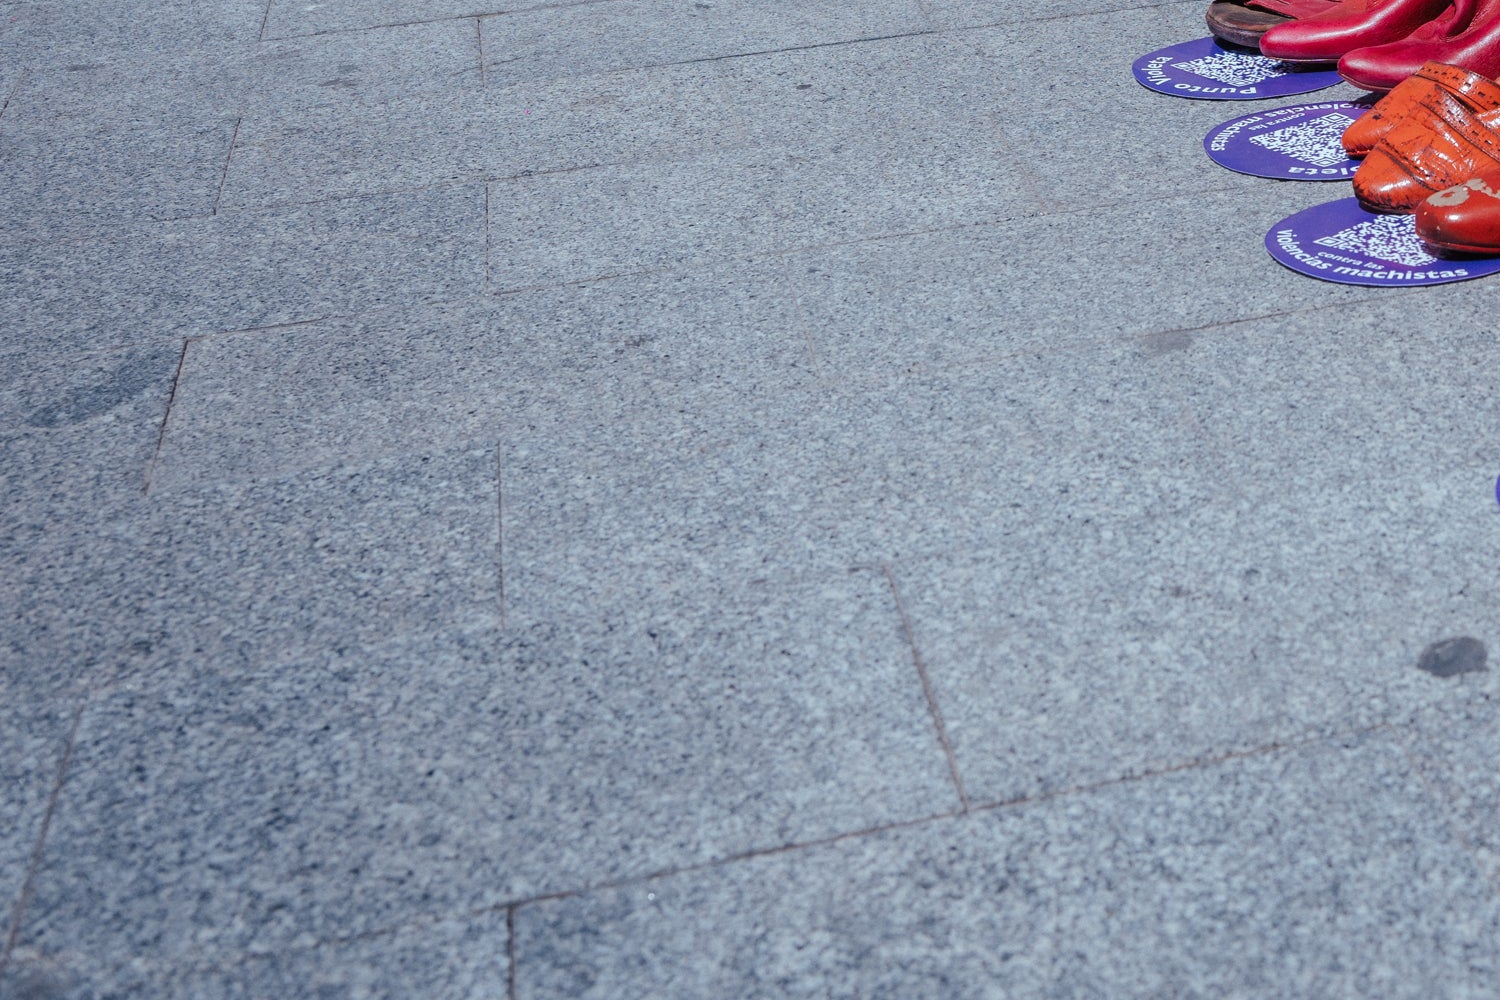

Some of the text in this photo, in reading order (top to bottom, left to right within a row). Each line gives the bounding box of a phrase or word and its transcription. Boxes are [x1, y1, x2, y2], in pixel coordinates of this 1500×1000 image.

[1140, 56, 1257, 95] Punto Violeta
[1210, 115, 1263, 151] machistas
[1270, 112, 1306, 126] contra
[1276, 228, 1469, 281] violencias machistas
[1317, 250, 1385, 271] contra las
